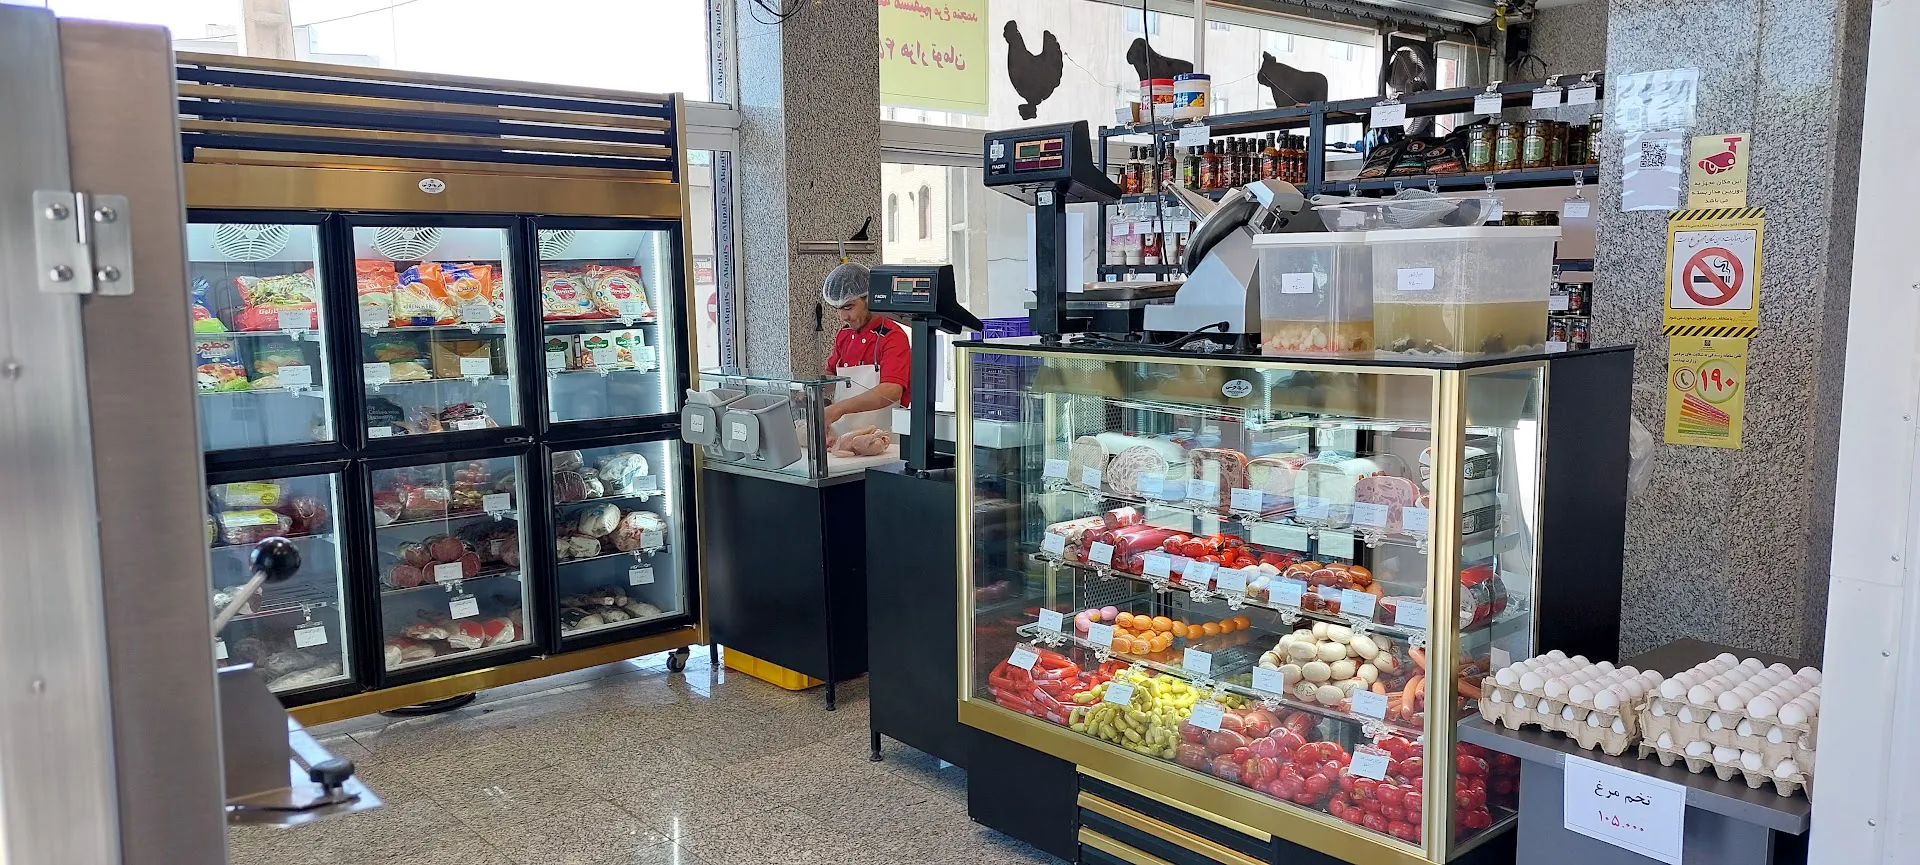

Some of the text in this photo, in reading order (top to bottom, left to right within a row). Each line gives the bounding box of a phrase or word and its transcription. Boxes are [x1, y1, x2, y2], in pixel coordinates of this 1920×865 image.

[1731, 178, 1742, 186] این
[1701, 367, 1735, 392] ۱۹۰
[1594, 779, 1652, 807] تخم مرغ
[1598, 809, 1645, 832] ۱۰۵.۰۰۰
